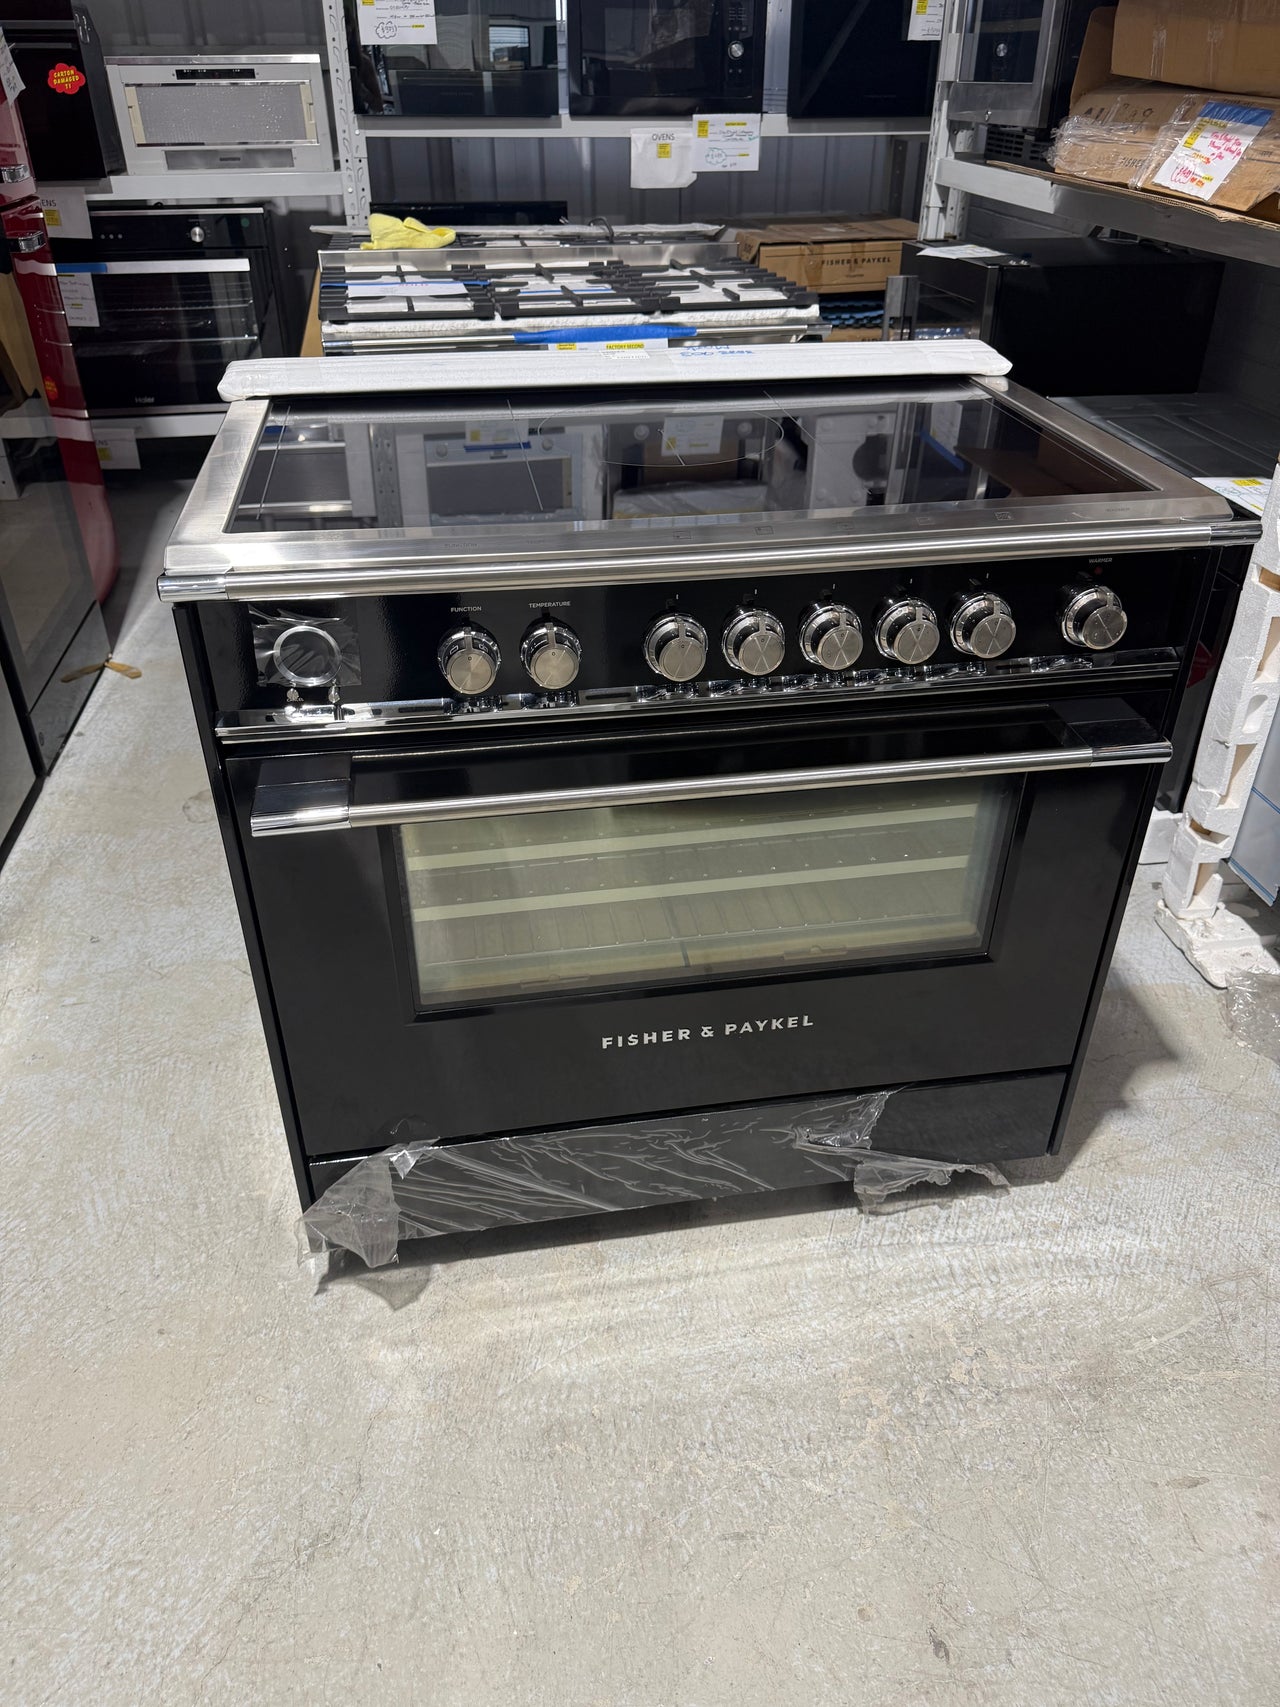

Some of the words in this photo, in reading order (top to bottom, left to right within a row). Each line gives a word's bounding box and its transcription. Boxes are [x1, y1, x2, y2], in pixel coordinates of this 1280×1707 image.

[54, 70, 75, 78] CARTON
[53, 75, 79, 85] DAMAGED
[652, 133, 675, 141] OVENS
[41, 199, 57, 207] ENS
[821, 258, 851, 266] FISHER
[862, 256, 890, 264] PAYKEL
[450, 605, 482, 613] FUNCTION
[528, 600, 571, 609] TEMPERATURE
[602, 1028, 691, 1049] FISHER
[700, 1026, 714, 1038] &
[725, 1015, 814, 1035] PAYKEL
